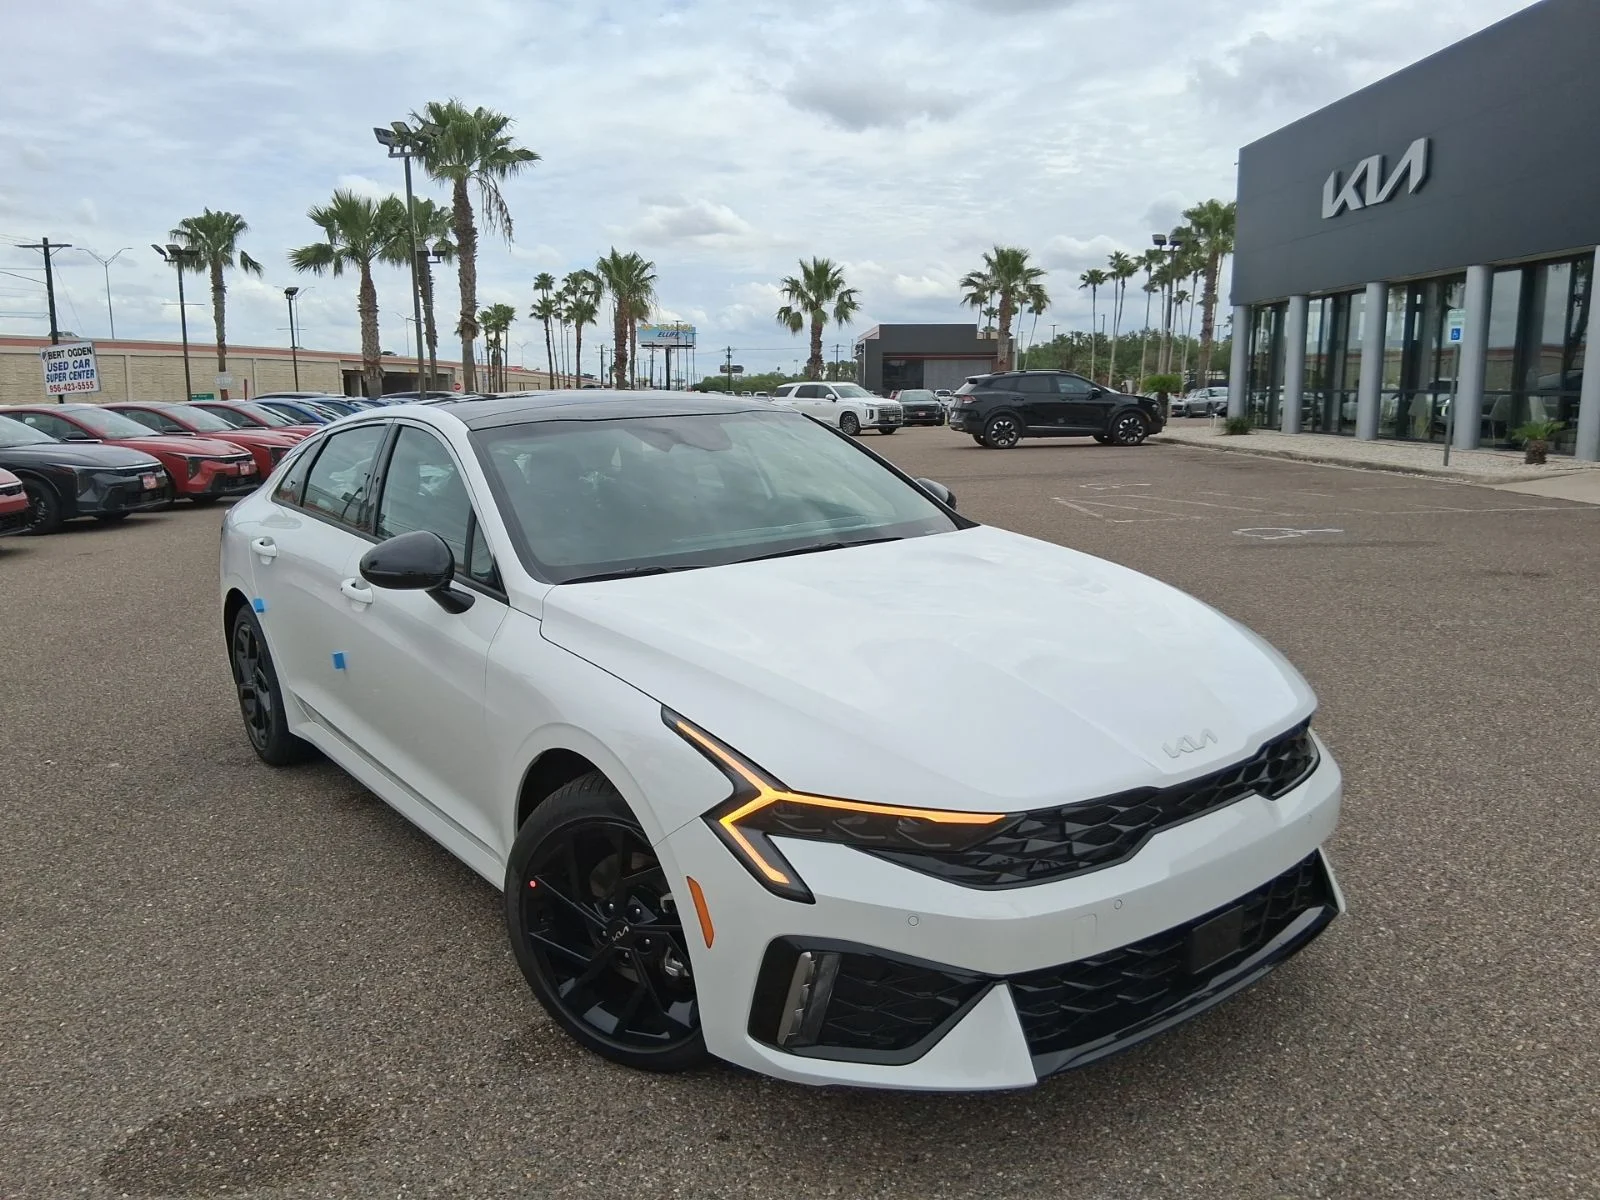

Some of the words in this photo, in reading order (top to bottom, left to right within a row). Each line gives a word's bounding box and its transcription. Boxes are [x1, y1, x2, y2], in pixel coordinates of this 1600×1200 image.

[1321, 137, 1428, 219] KIA
[47, 350, 65, 360] BERT
[67, 346, 92, 358] OGDEN
[47, 361, 69, 372] USED
[72, 358, 91, 370] CAR
[46, 372, 67, 383] SUPER
[68, 368, 95, 381] CENTER
[49, 380, 95, 393] 956-423-5555
[1161, 728, 1218, 759] KIA
